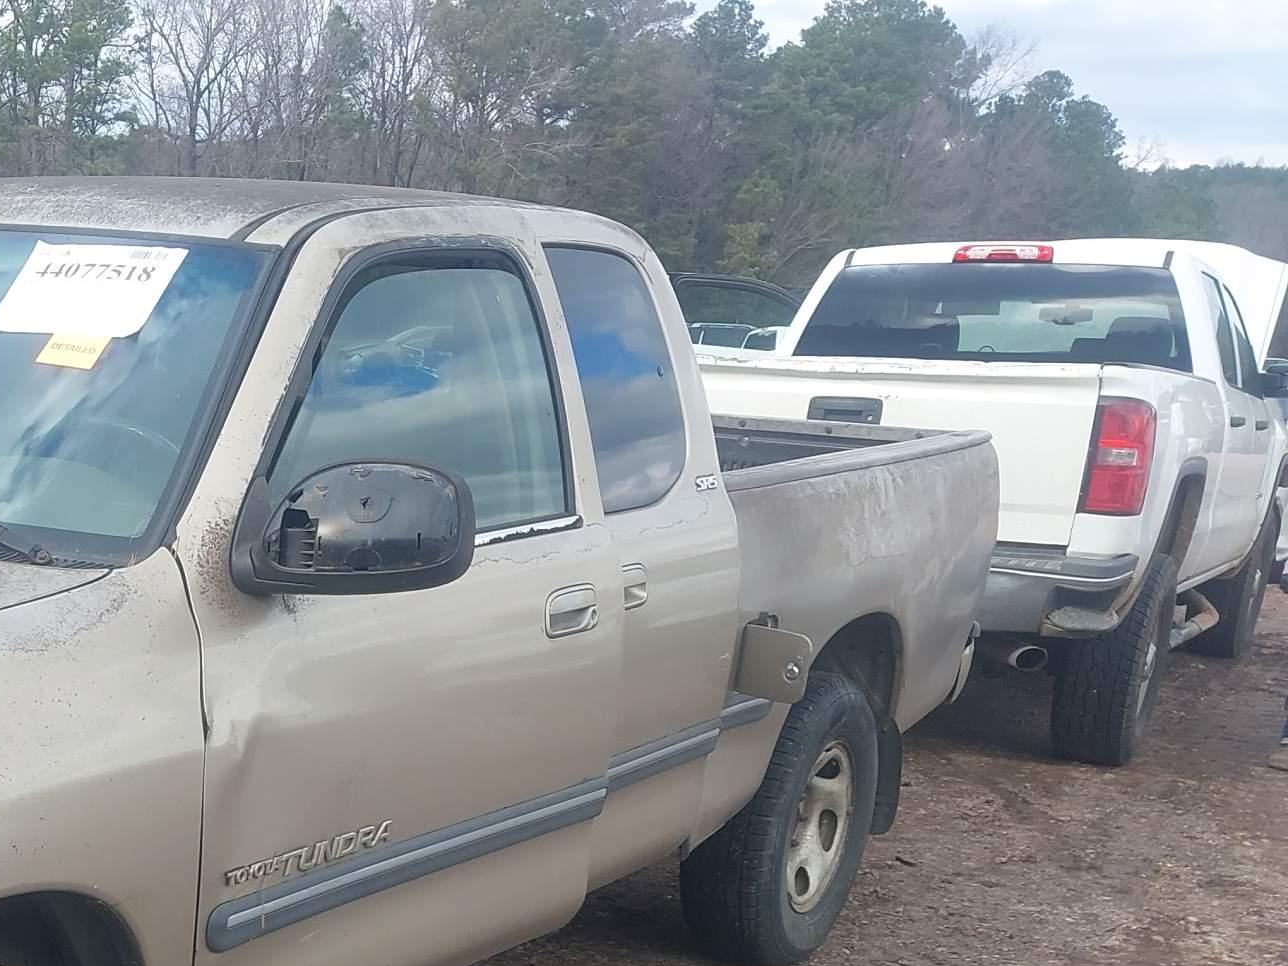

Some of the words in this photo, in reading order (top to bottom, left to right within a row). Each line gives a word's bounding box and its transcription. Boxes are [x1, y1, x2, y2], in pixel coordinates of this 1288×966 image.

[34, 262, 156, 282] 44077518
[51, 343, 96, 354] DETAILED
[696, 475, 717, 493] SR5
[224, 856, 281, 887] TOYOTA
[280, 819, 393, 876] TUNDRA
